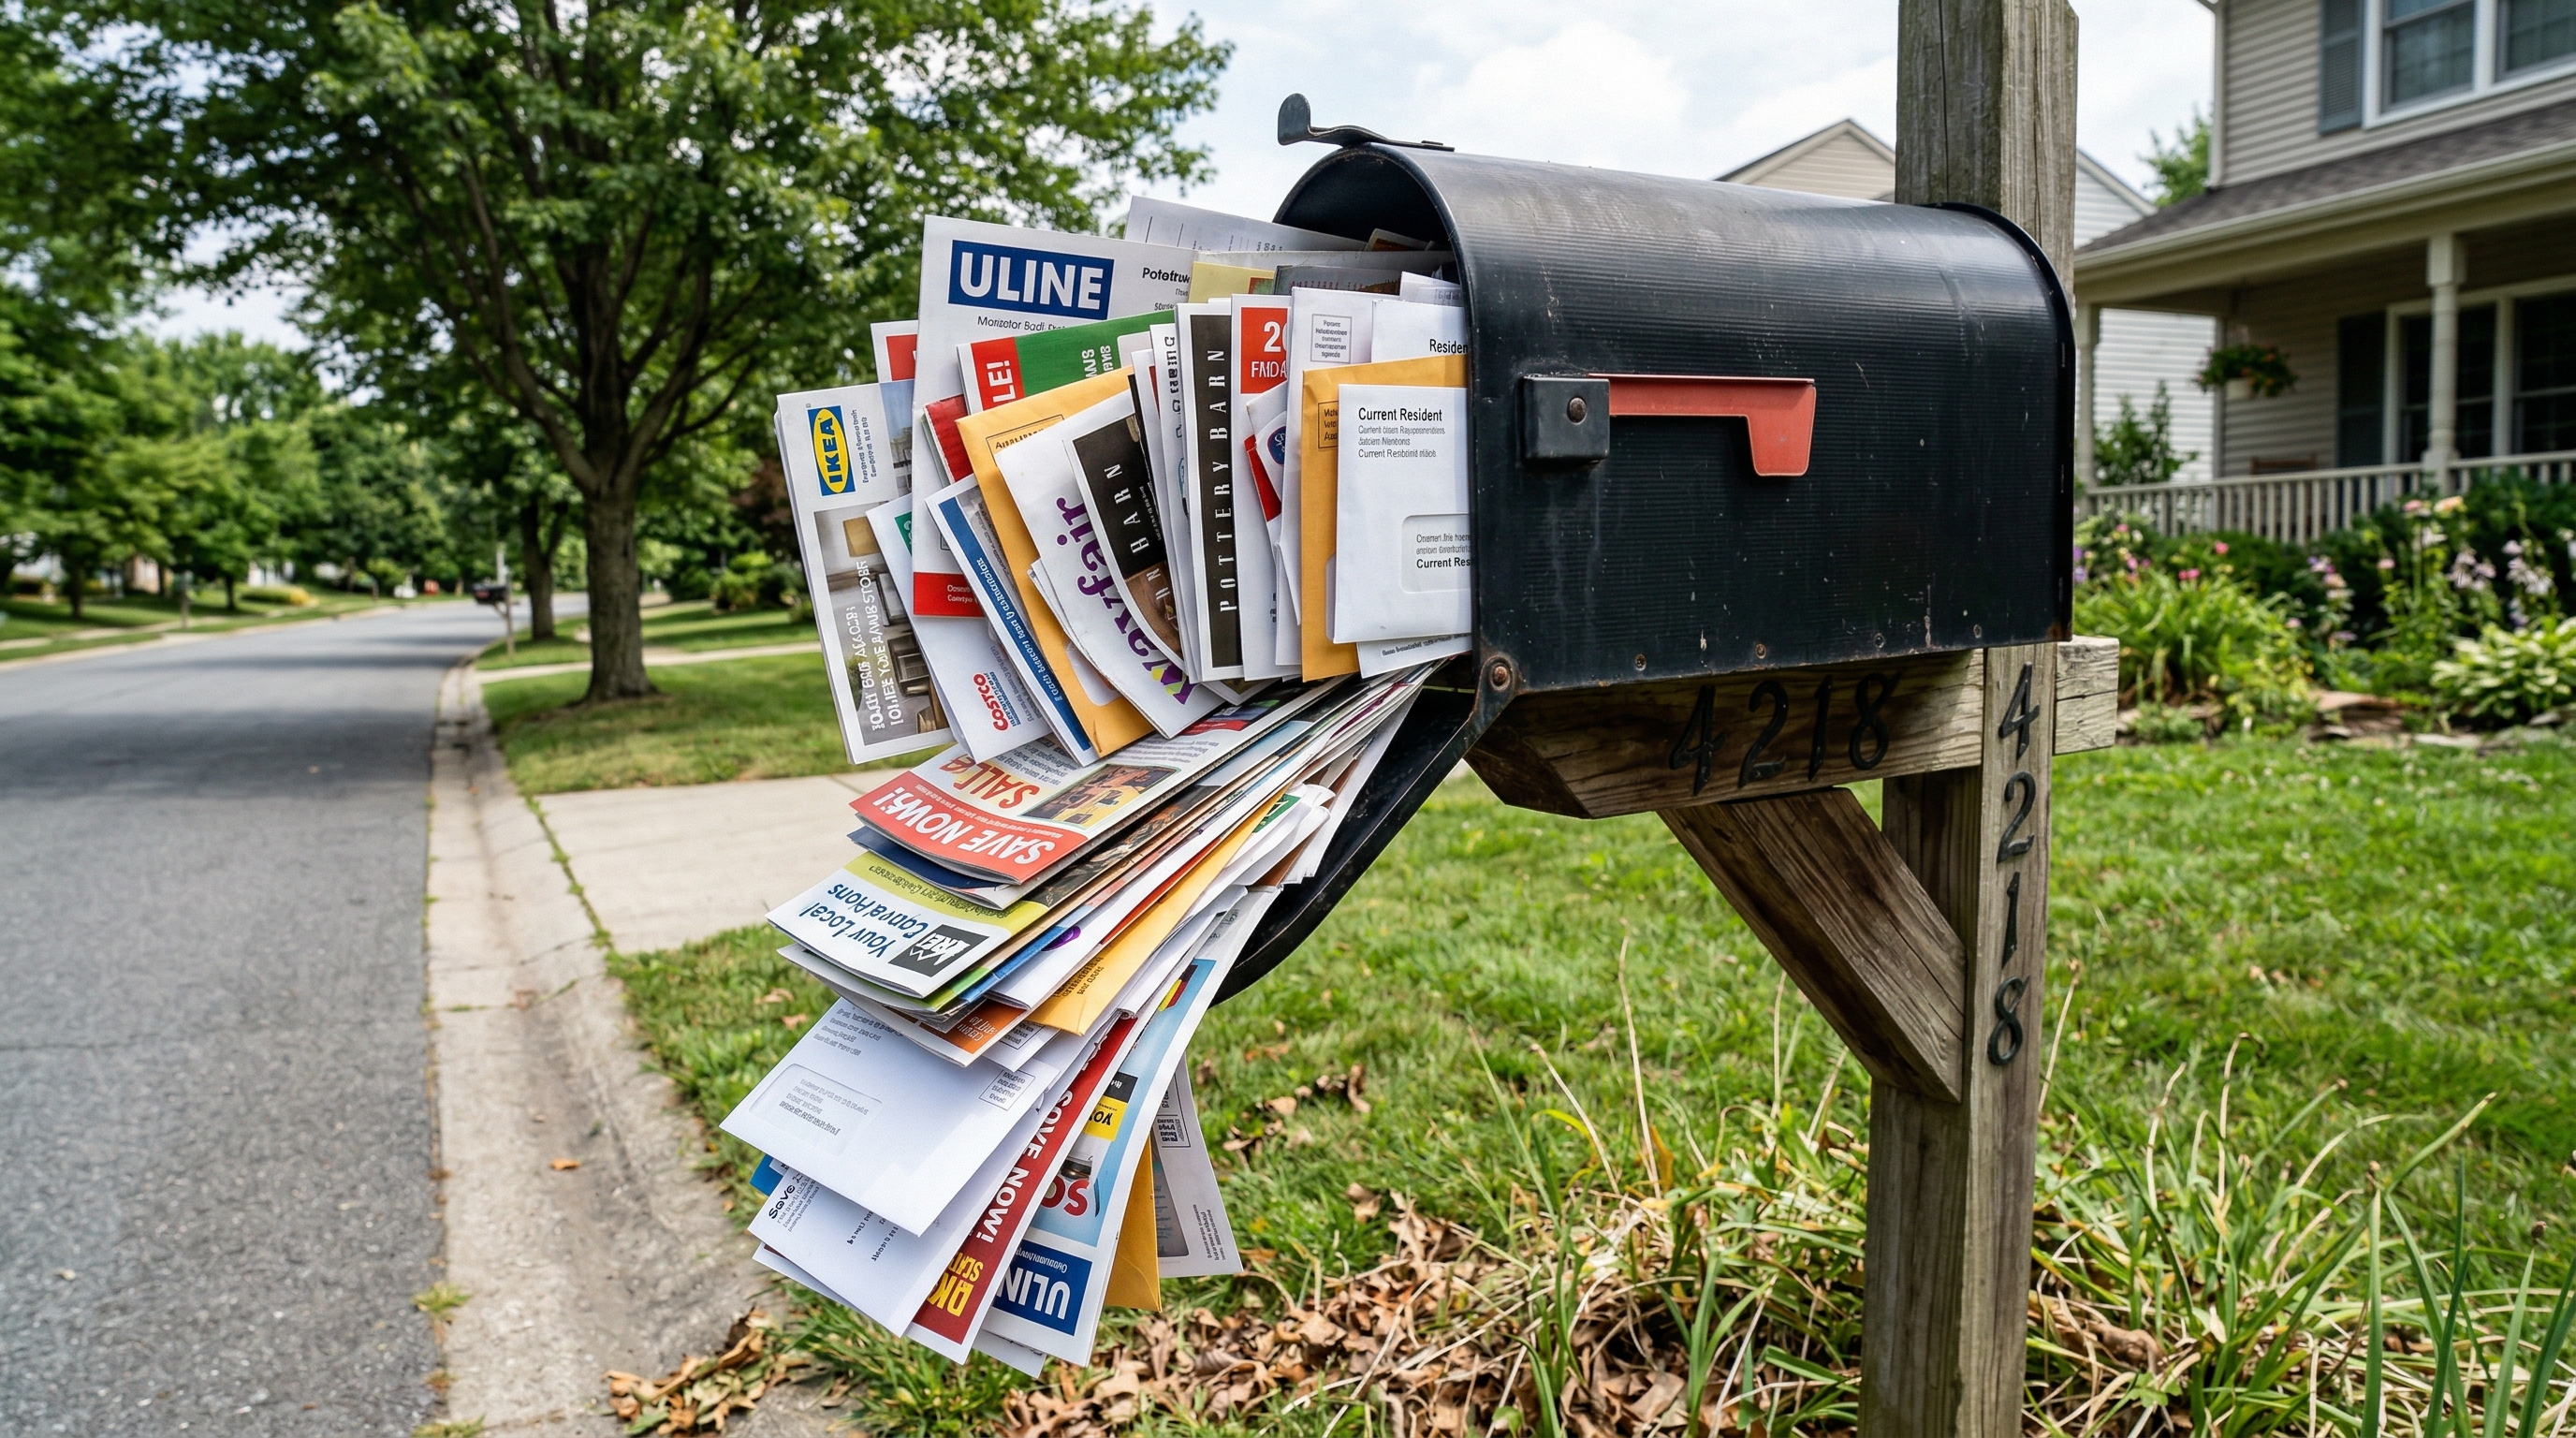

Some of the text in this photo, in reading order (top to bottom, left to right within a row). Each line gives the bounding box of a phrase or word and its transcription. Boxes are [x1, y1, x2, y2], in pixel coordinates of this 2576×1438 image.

[959, 251, 1105, 311] ULINE
[1358, 407, 1442, 422] Current Resident
[820, 418, 843, 484] IKEA
[1207, 349, 1238, 613] POTTERY BARN
[1416, 558, 1452, 569] Current
[1669, 671, 1902, 796] 4218
[958, 829, 1056, 865] SAVE
[1987, 661, 2041, 1066] 4218
[798, 902, 856, 938] Local
[976, 1167, 1031, 1244] NOW!
[995, 1267, 1072, 1321] ULIN
